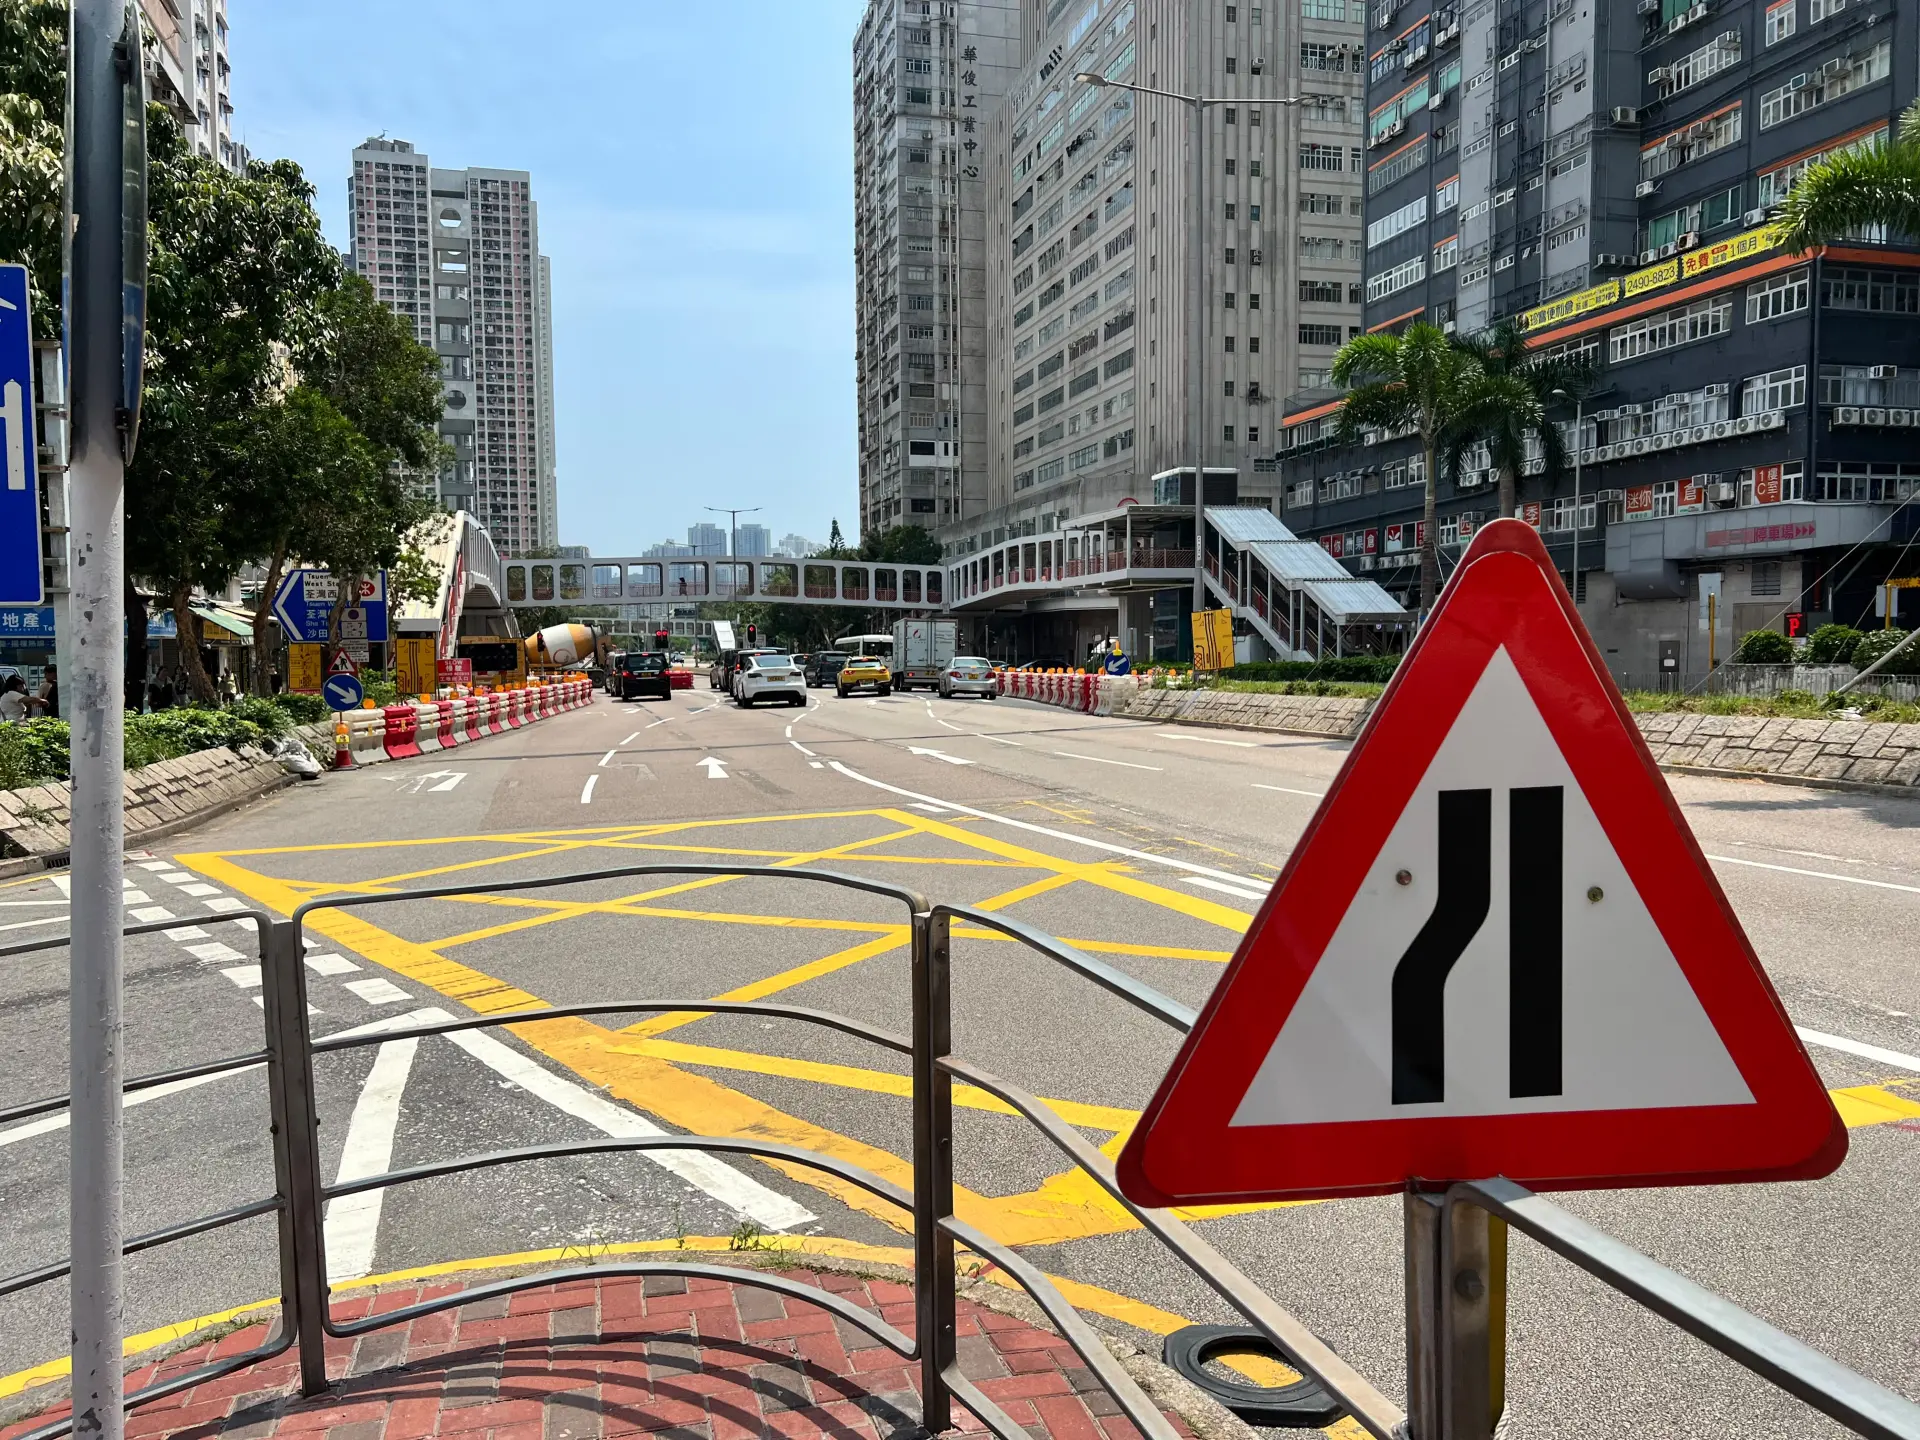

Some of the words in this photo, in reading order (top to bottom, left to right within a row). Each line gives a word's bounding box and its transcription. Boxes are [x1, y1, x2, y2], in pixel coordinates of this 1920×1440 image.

[961, 45, 978, 178] 華俊工業中心
[1685, 252, 1709, 273] 免費
[1730, 236, 1757, 257] 1個月
[1627, 266, 1676, 293] 2490-8823
[1525, 505, 1539, 524] 季
[1626, 489, 1652, 510] 迷你
[1755, 524, 1794, 542] 停車場
[2, 612, 40, 628] 地產
[1789, 617, 1800, 637] P
[307, 628, 328, 639] 沙田
